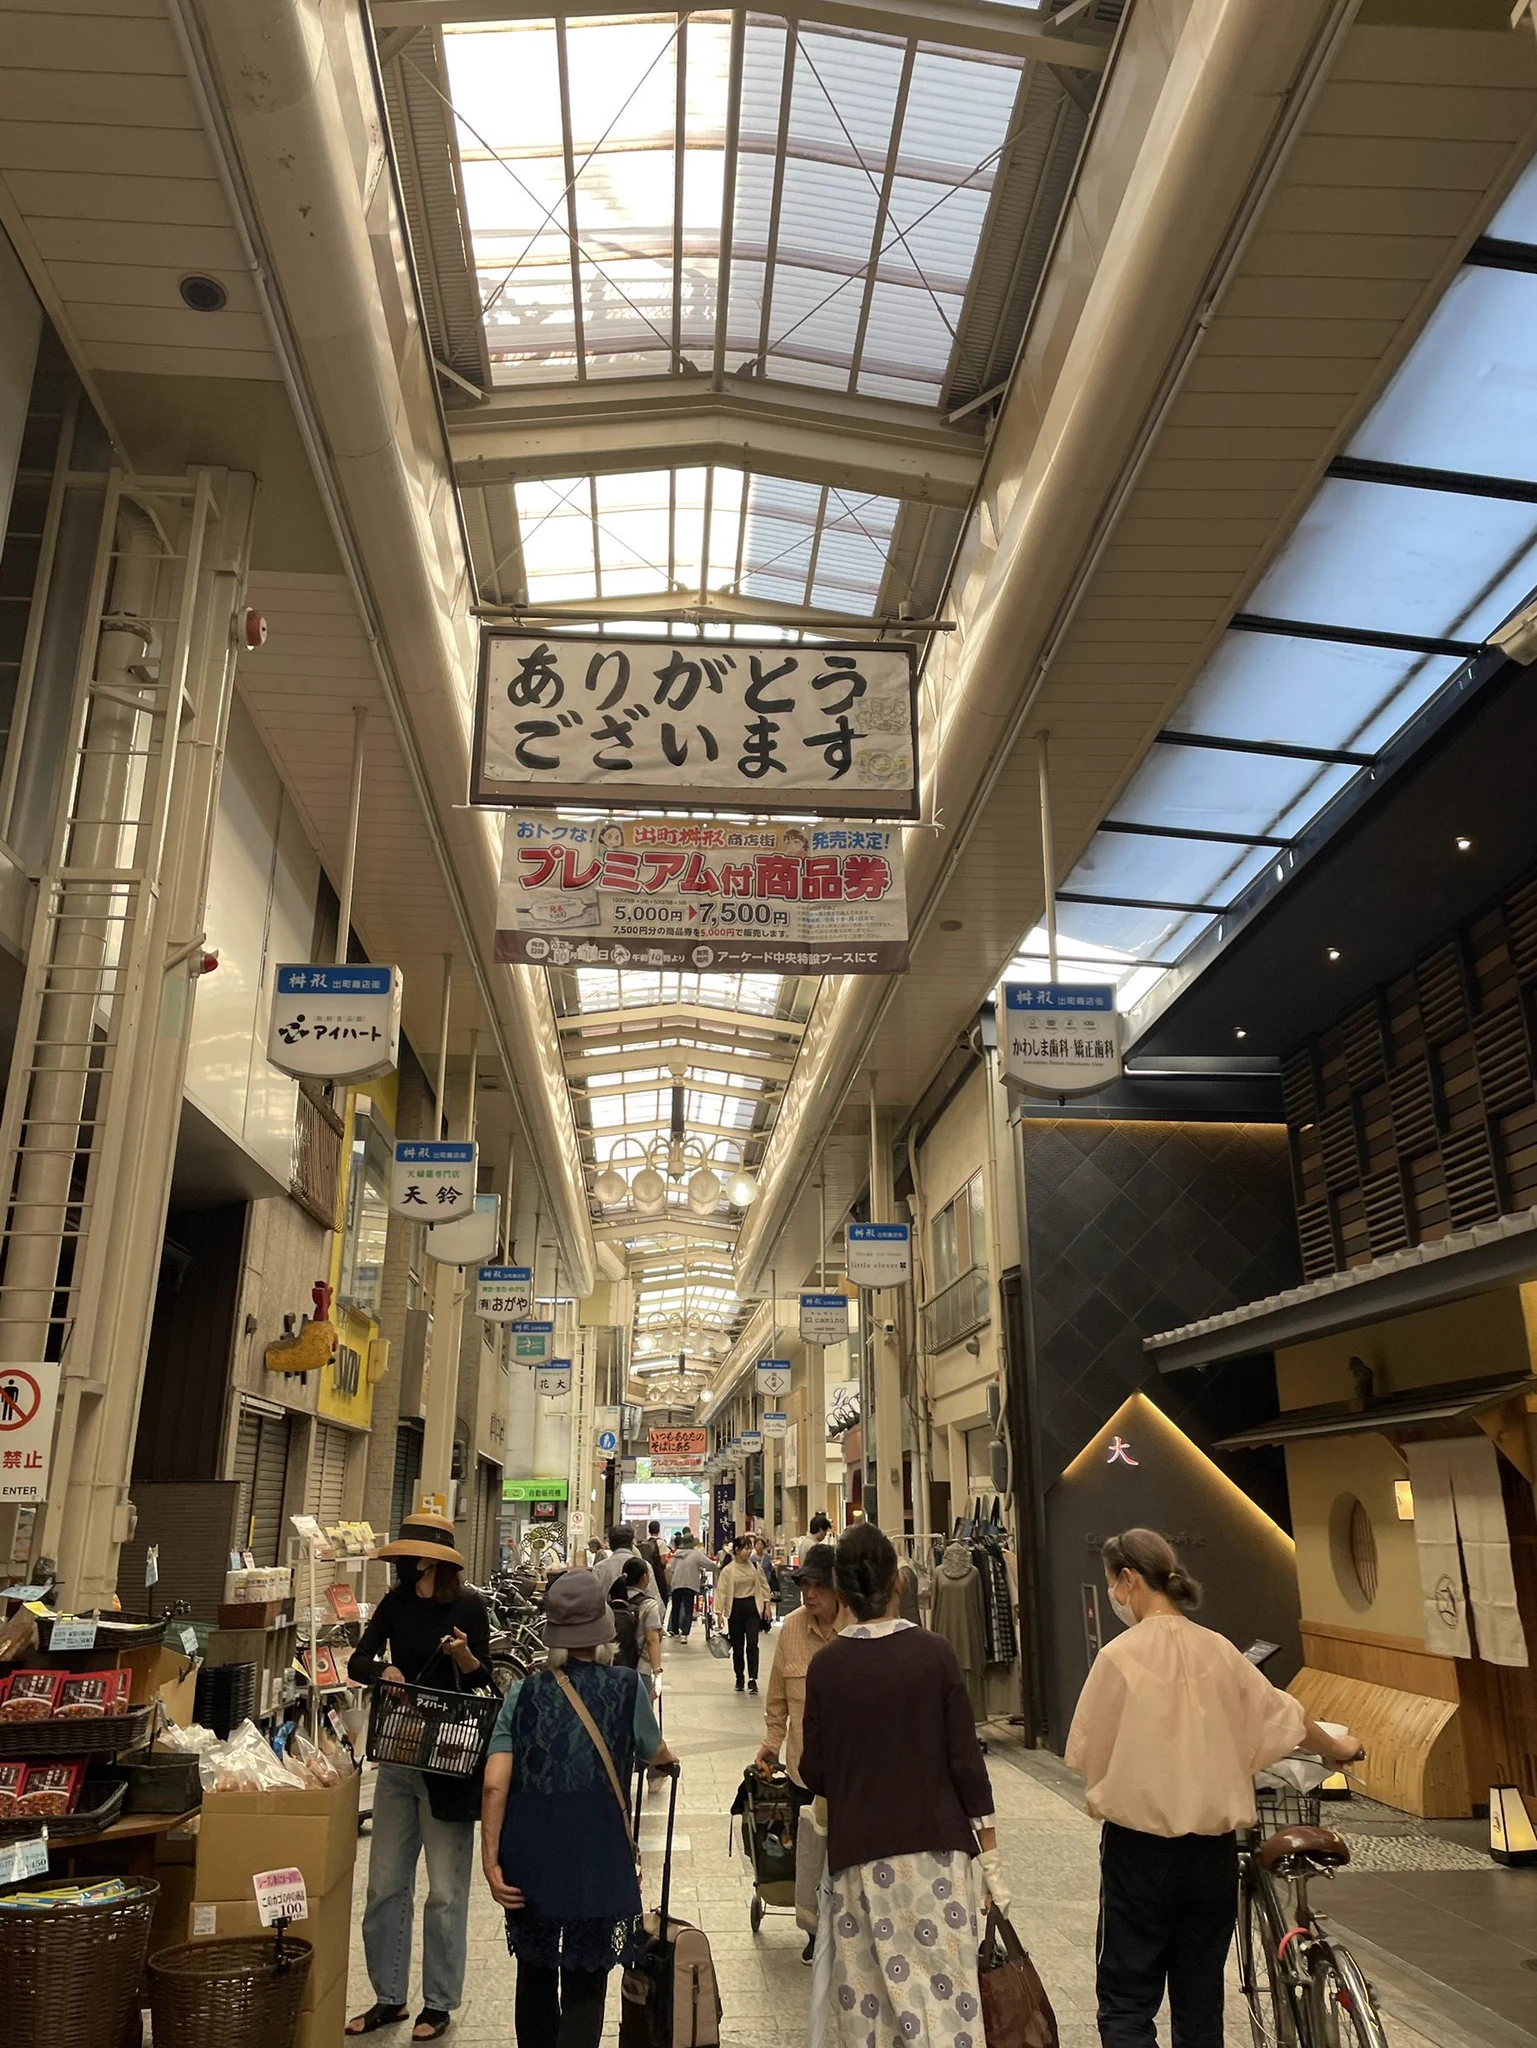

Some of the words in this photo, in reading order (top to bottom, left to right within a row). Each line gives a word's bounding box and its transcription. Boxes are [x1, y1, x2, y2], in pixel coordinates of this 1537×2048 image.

[507, 643, 868, 714] ありがとう
[514, 703, 868, 781] ございます
[518, 845, 892, 902] プレミアム付商品券
[614, 905, 683, 923] 5,000円
[699, 902, 790, 927] 7,500円
[717, 951, 878, 965] アーケード中央特設ブースにて
[314, 1025, 382, 1042] アイハート
[401, 1185, 463, 1205] 天鈴
[815, 1316, 845, 1324] camino
[2, 1450, 43, 1469] 禁止
[1106, 1435, 1140, 1466] 大
[2, 1486, 38, 1495] ENTER
[416, 1697, 449, 1712] アイハート
[280, 1901, 302, 1916] 100
